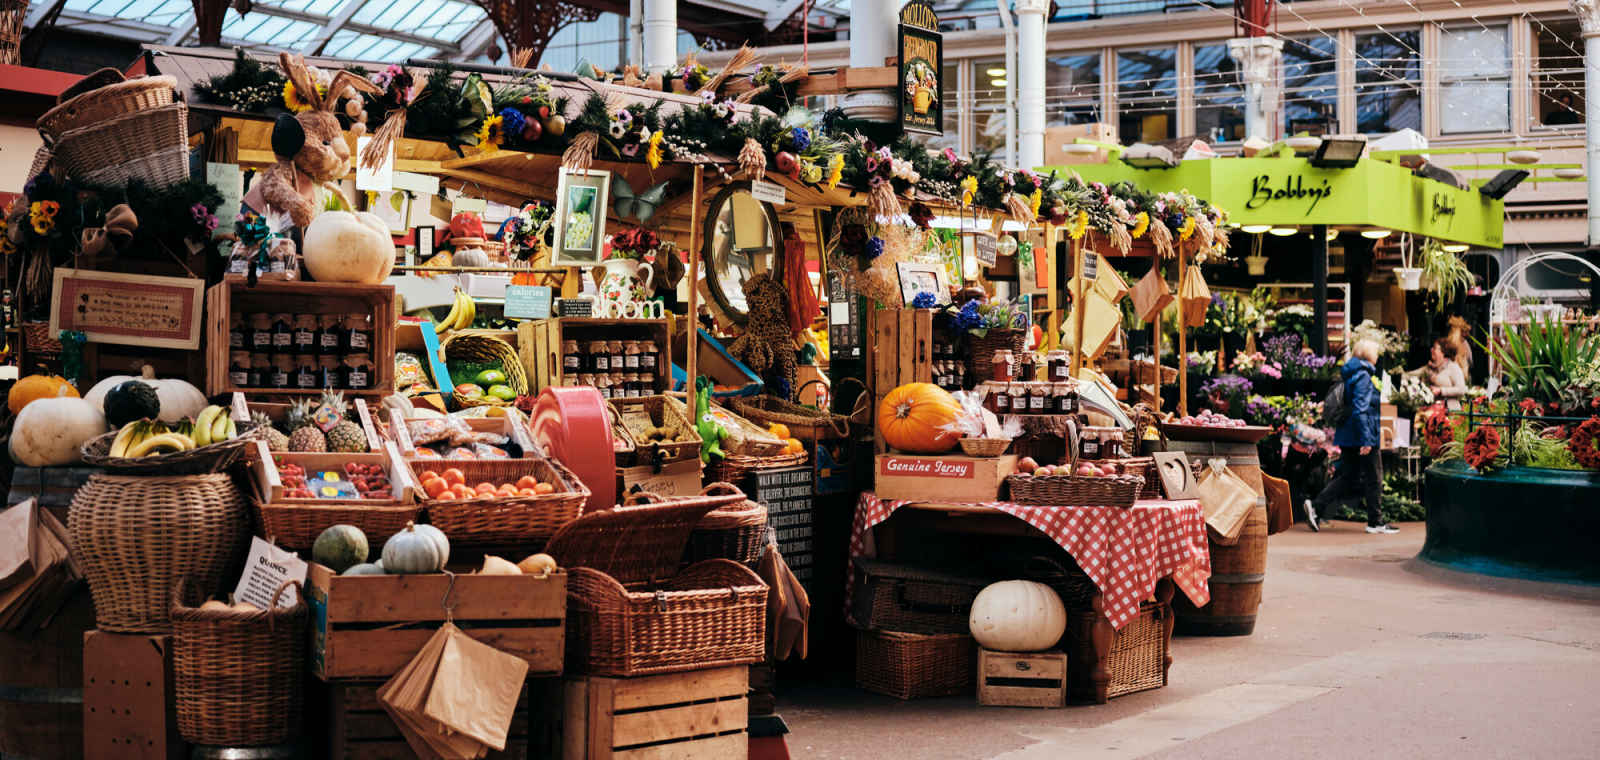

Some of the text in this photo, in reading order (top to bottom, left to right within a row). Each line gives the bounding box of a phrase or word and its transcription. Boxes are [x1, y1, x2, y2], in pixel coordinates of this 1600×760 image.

[1246, 174, 1332, 216] Bobby's
[887, 459, 967, 476] Genuine Jersey
[259, 555, 289, 577] QUINCE
